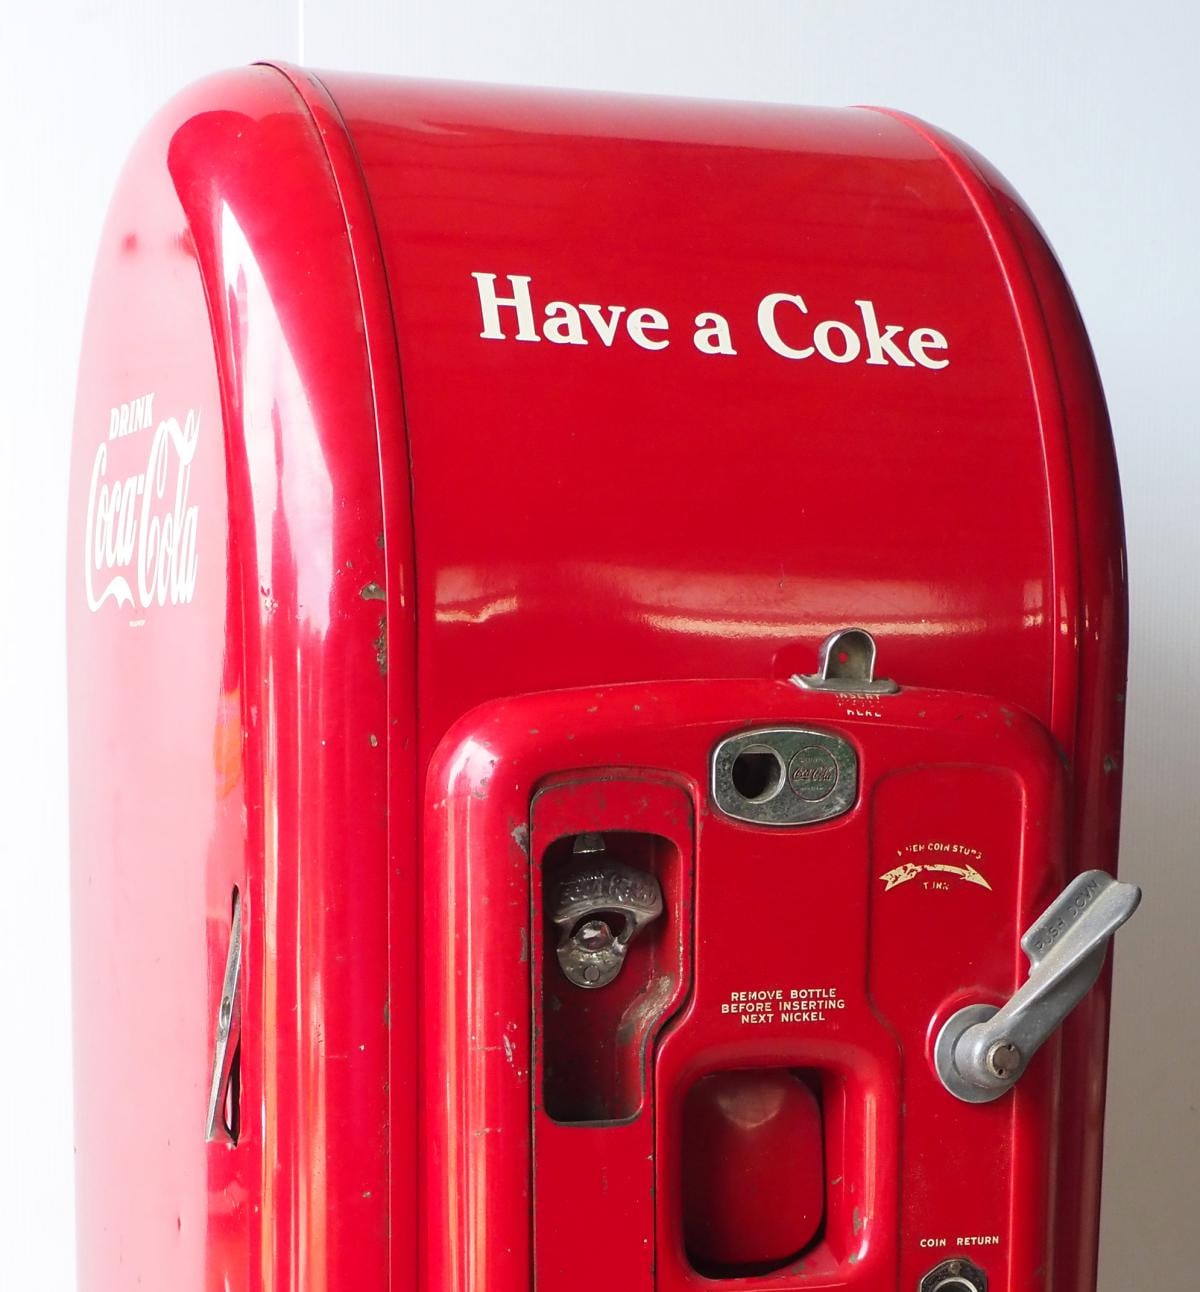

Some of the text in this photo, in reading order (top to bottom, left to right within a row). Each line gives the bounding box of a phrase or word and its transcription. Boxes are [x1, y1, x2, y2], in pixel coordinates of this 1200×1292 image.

[471, 271, 950, 370] Have a Coke
[109, 392, 155, 441] DRINK
[84, 408, 201, 613] Coca-Cola
[927, 842, 950, 852] COIN
[731, 988, 837, 1002] REMOVE BOTTLE
[721, 1000, 845, 1014] BEFORE INSERTING
[741, 1012, 826, 1024] NEXT NICKEL
[920, 1236, 1000, 1248] COIN RETURN
